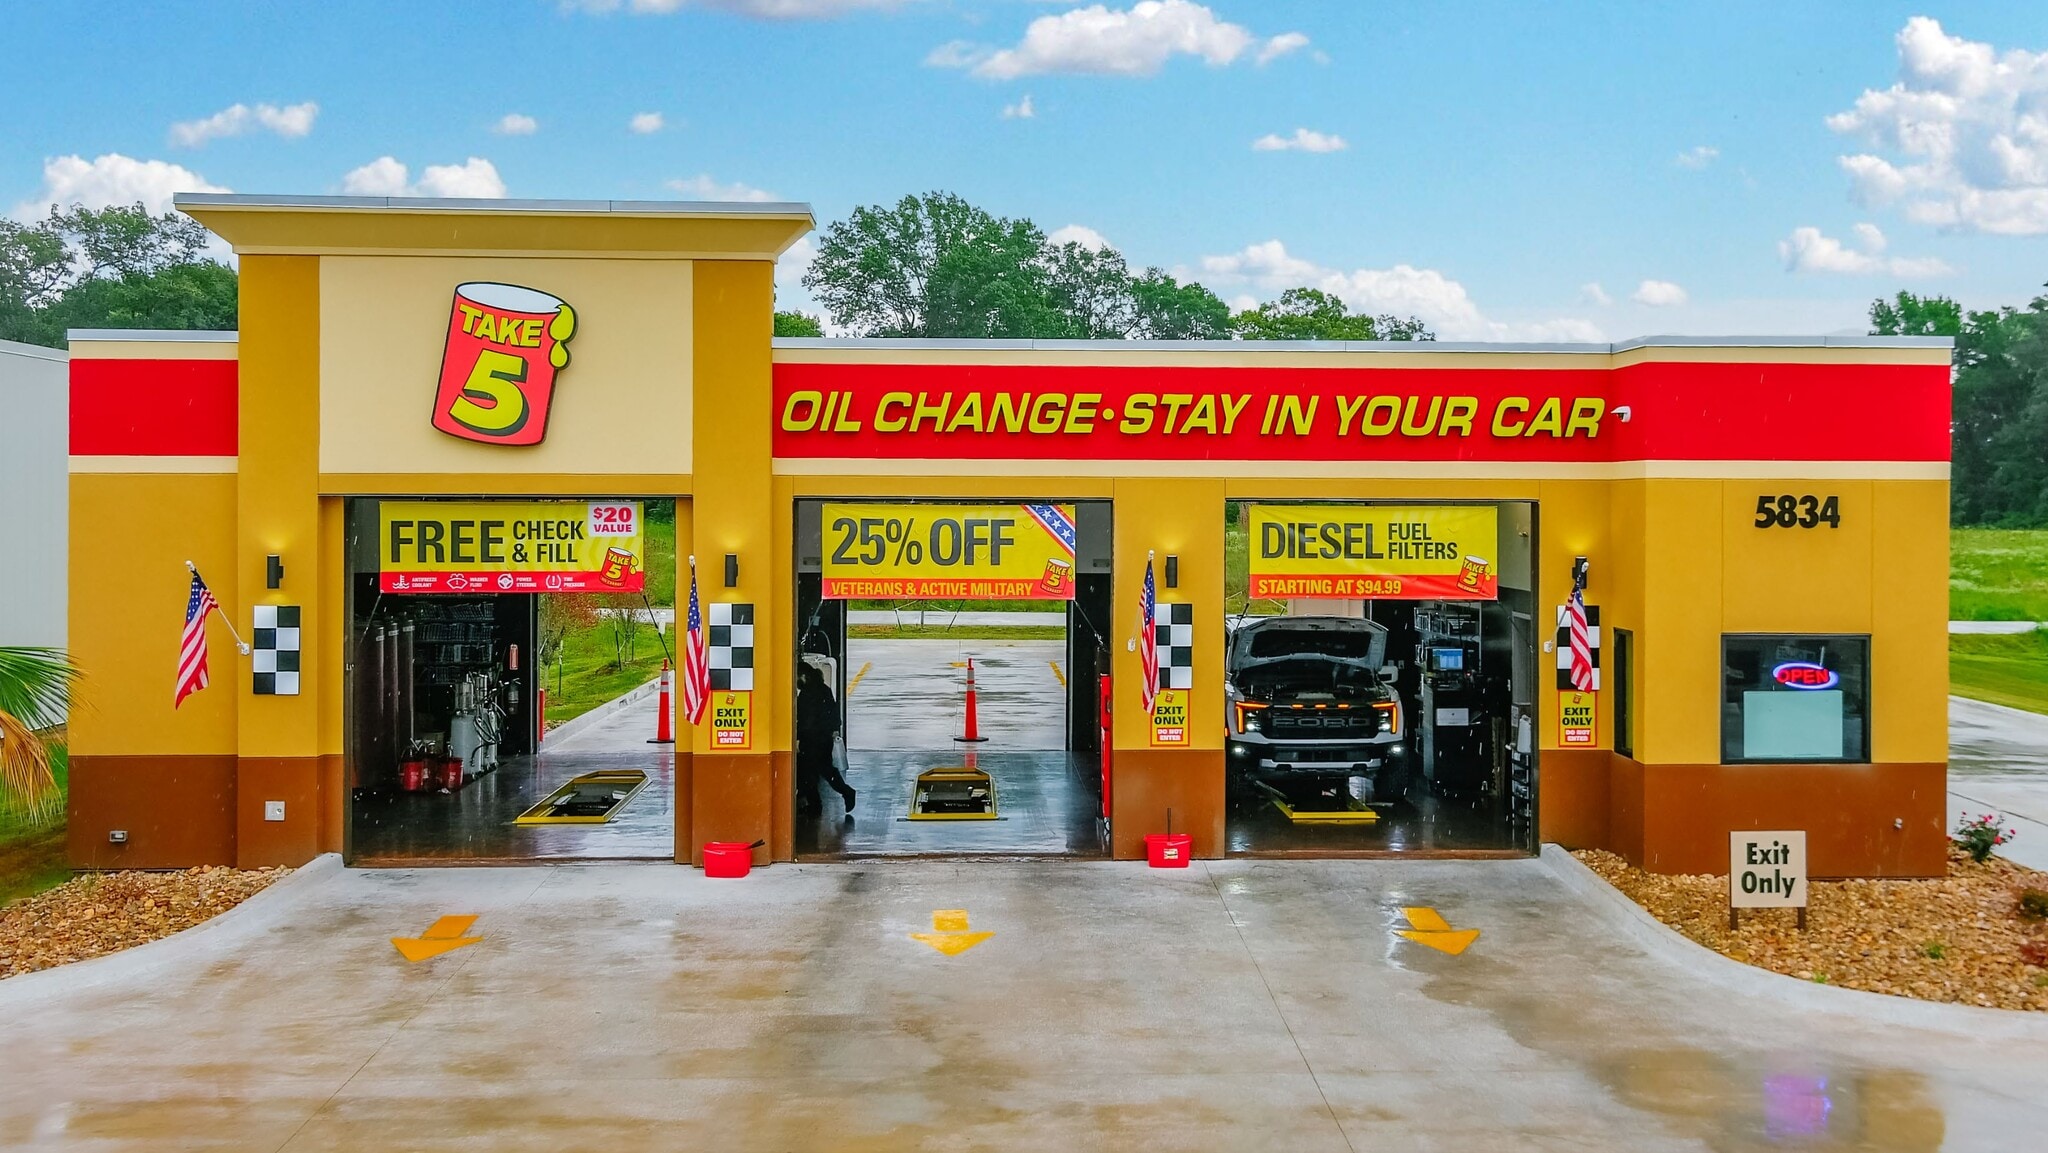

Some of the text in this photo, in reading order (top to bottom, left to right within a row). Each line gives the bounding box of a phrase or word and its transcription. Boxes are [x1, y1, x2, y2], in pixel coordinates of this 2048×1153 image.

[459, 303, 545, 348] TAKE
[449, 348, 529, 437] 5
[781, 390, 862, 433] OIL
[1260, 394, 1320, 436] IN
[1335, 395, 1479, 437] YOUR
[1490, 396, 1607, 438] CAR
[593, 506, 632, 523] $20
[1754, 494, 1841, 529] 5834
[593, 524, 632, 533] VALUE
[390, 520, 584, 563] FREE CHECK
[831, 517, 1015, 567] 25% OFF
[1261, 522, 1432, 560] DIESEL FUEL
[511, 543, 579, 563] & FILL
[1388, 541, 1458, 560] FILTERS
[607, 552, 630, 566] TAKE
[1463, 559, 1485, 574] TAKE
[605, 563, 622, 579] 5
[1046, 562, 1067, 576] TAKE
[1046, 573, 1061, 588] 5
[1258, 578, 1402, 595] STARTING AT $94.99
[1462, 571, 1479, 586] 5
[831, 581, 904, 596] VETERANS
[905, 582, 917, 596] &
[919, 582, 969, 597] ACTIVE
[970, 582, 1034, 597] MILITARY
[1776, 668, 1829, 685] OPEN
[716, 708, 745, 717] EXIT
[1156, 706, 1183, 715] EXIT
[1564, 707, 1590, 716] EXIT
[714, 718, 747, 728] ONLY
[1154, 716, 1185, 725] ONLY
[1562, 717, 1592, 726] ONLY
[1746, 840, 1790, 865] Exit
[1741, 868, 1796, 899] Only
